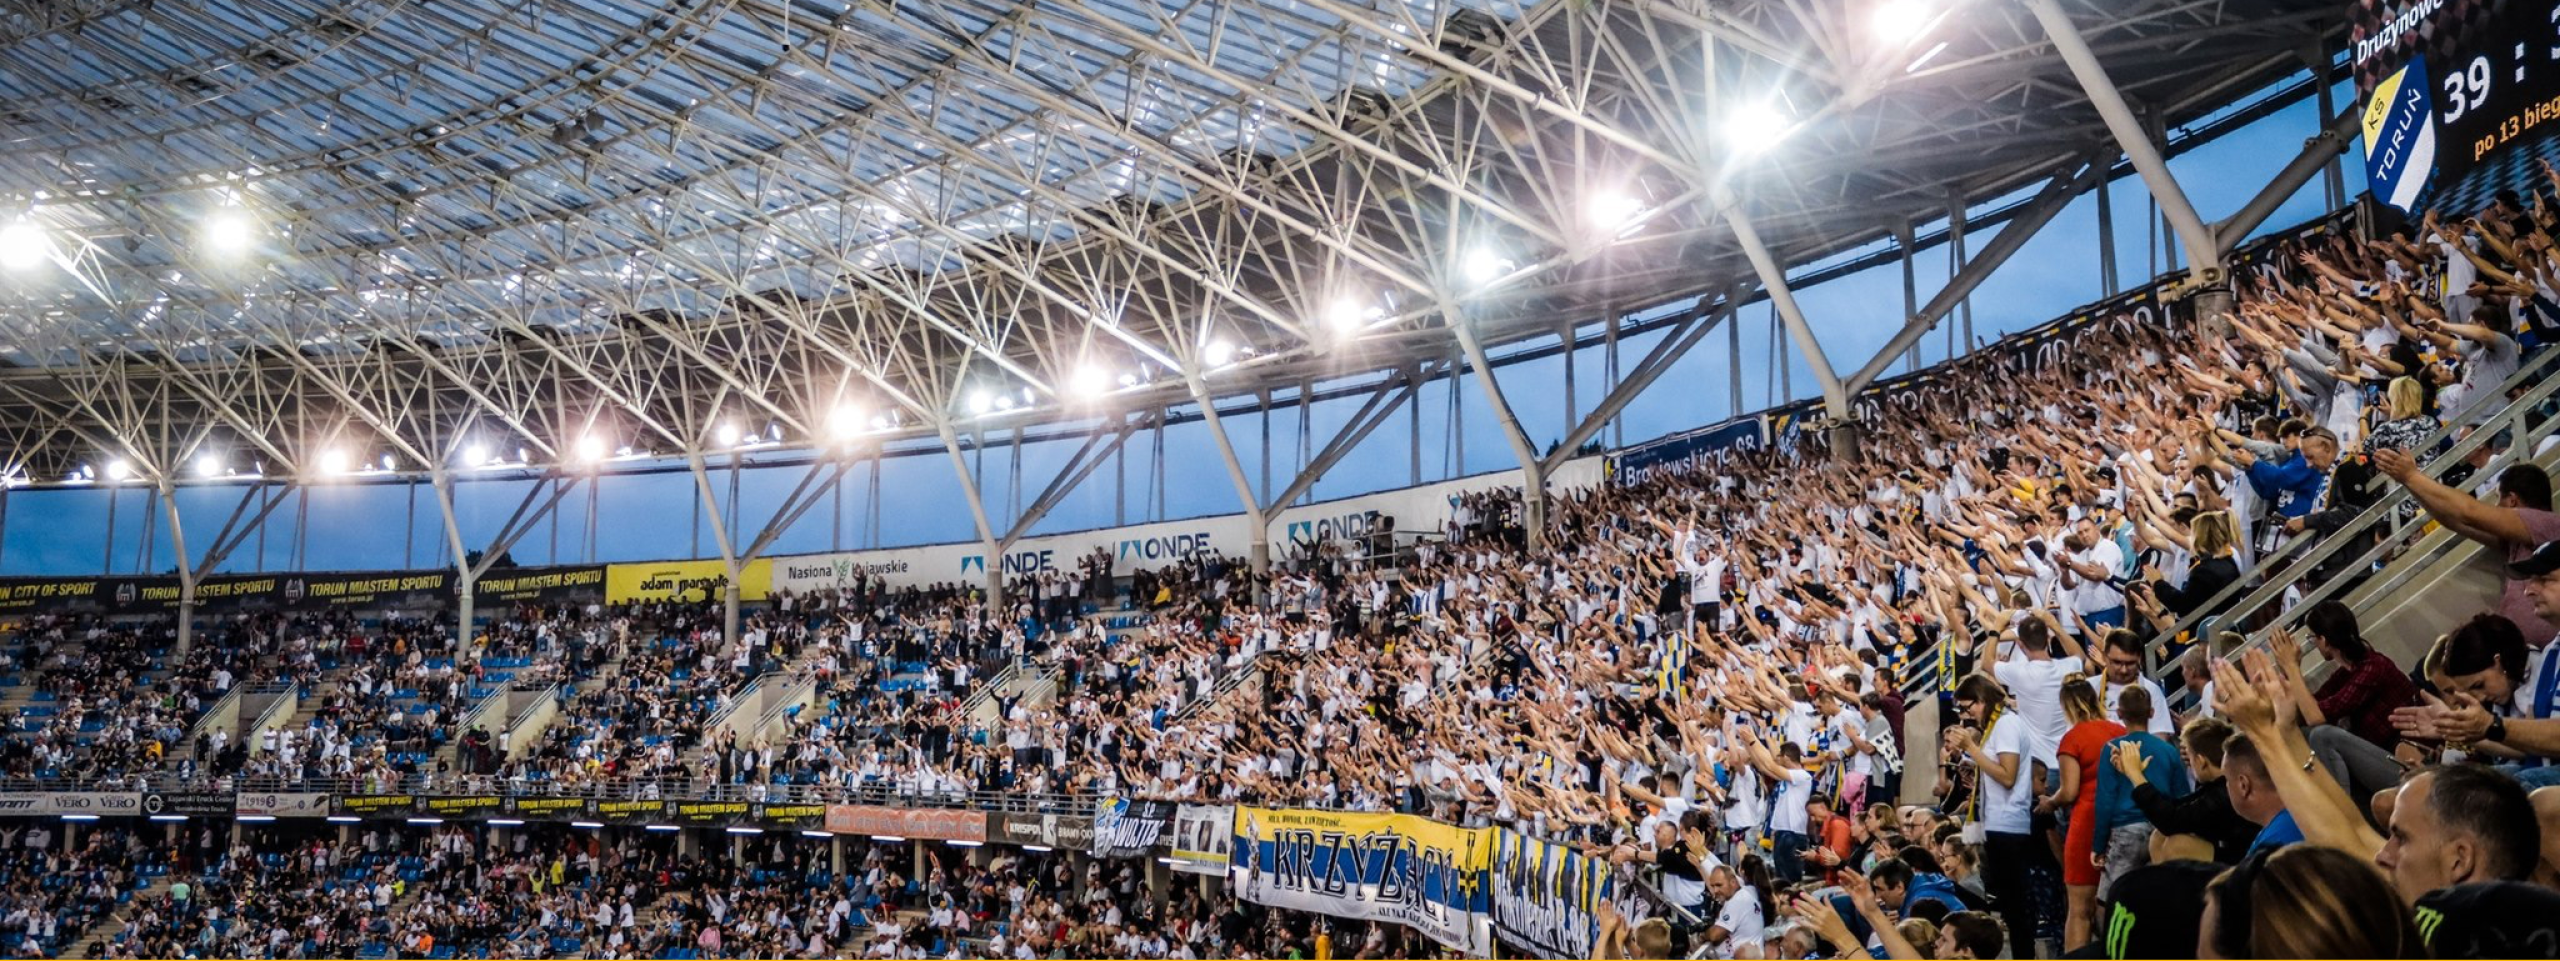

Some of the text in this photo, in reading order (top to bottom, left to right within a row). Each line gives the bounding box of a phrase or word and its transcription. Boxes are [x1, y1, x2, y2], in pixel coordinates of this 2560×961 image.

[2444, 56, 2490, 124] 39
[2368, 98, 2385, 130] KS
[2376, 89, 2421, 182] TORUŃ
[2475, 134, 2494, 162] po
[2499, 115, 2519, 144] 13
[1145, 533, 1211, 560] ONDE
[788, 564, 832, 580] Nasiona
[1002, 550, 1054, 574] NDE
[14, 585, 41, 599] CITY
[41, 584, 58, 597] OF
[58, 581, 98, 597] SPORT
[233, 579, 275, 595] SPORTU
[348, 578, 399, 595] MIASTEM
[400, 575, 443, 591] SPORTU
[516, 573, 562, 591] MIASTEM
[563, 570, 602, 586] SPORTU
[640, 576, 673, 591] adam
[55, 797, 91, 808] VERO
[99, 797, 136, 808] VERO
[245, 796, 266, 807] 1919
